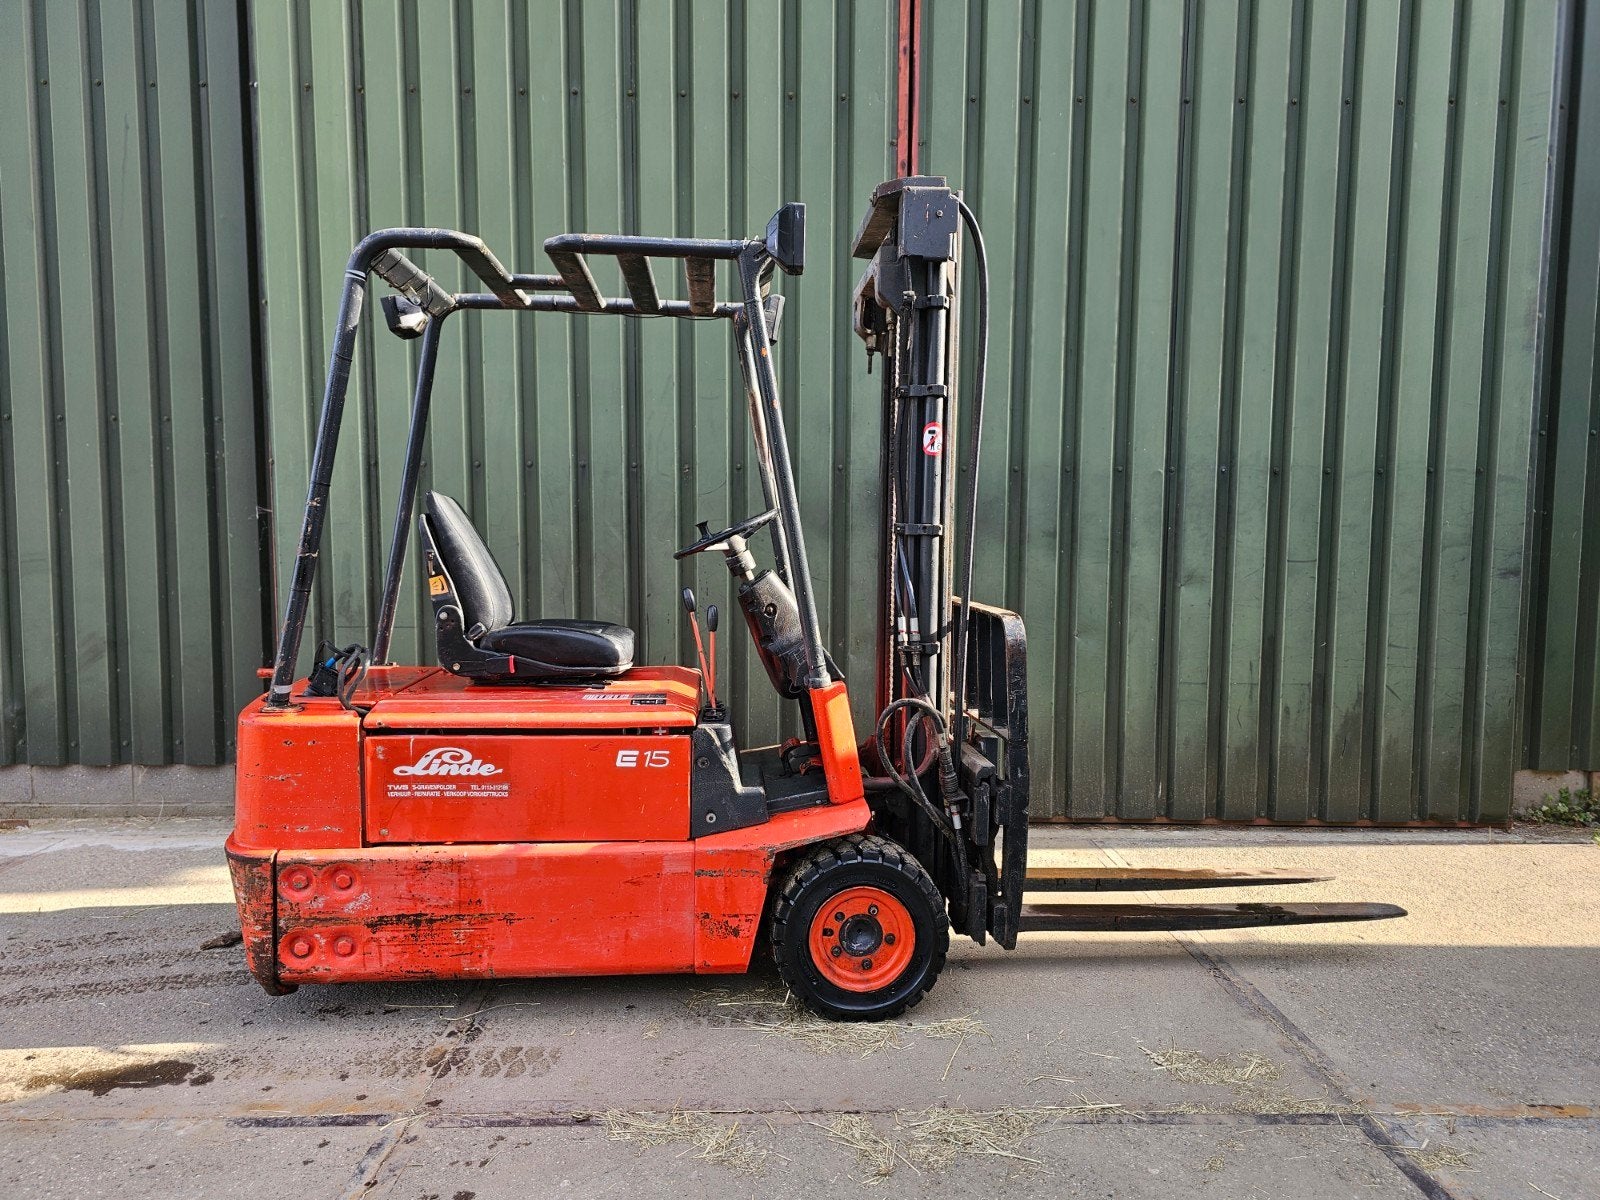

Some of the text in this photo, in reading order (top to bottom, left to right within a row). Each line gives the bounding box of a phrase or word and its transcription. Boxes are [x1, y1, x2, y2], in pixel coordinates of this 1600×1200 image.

[393, 747, 503, 776] Linde
[615, 750, 670, 767] E 15
